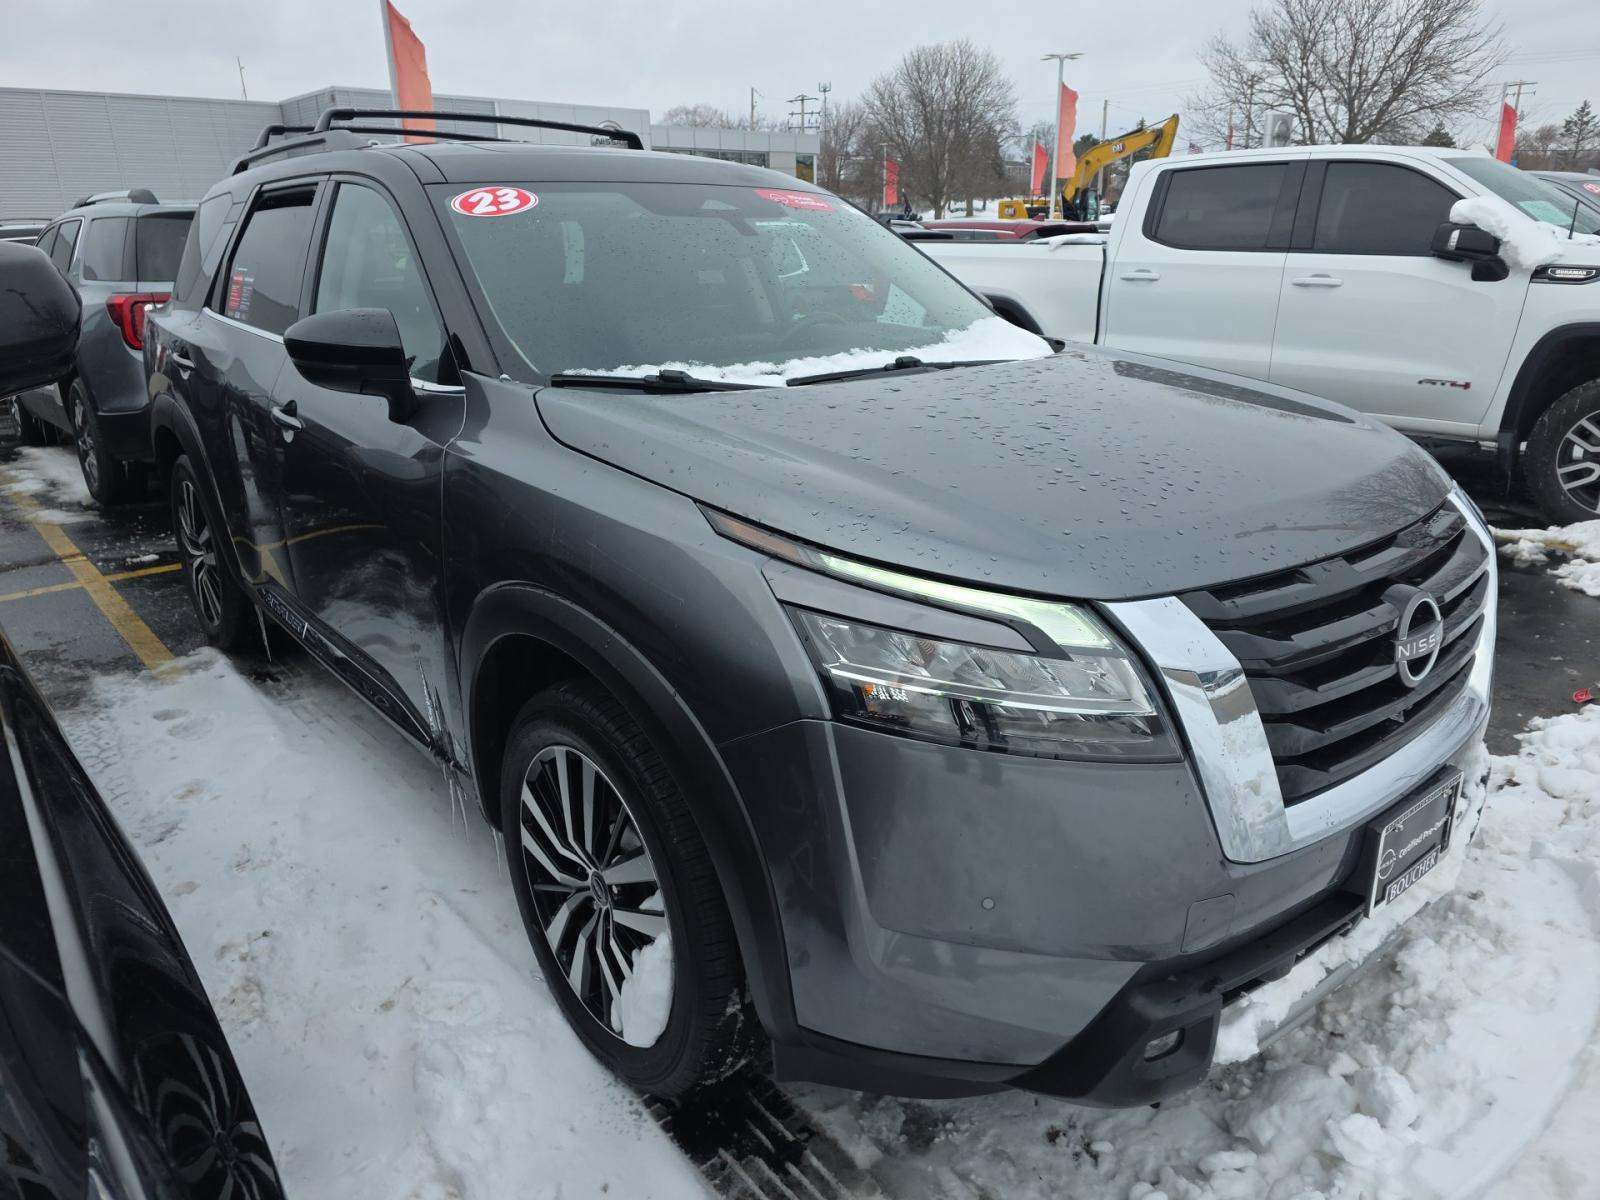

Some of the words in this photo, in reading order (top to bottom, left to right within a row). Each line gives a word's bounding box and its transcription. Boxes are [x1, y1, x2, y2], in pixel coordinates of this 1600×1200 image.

[468, 188, 521, 214] 23
[1417, 379, 1471, 390] AT4
[1398, 633, 1437, 659] NISS
[1389, 851, 1437, 901] BOUCHER
